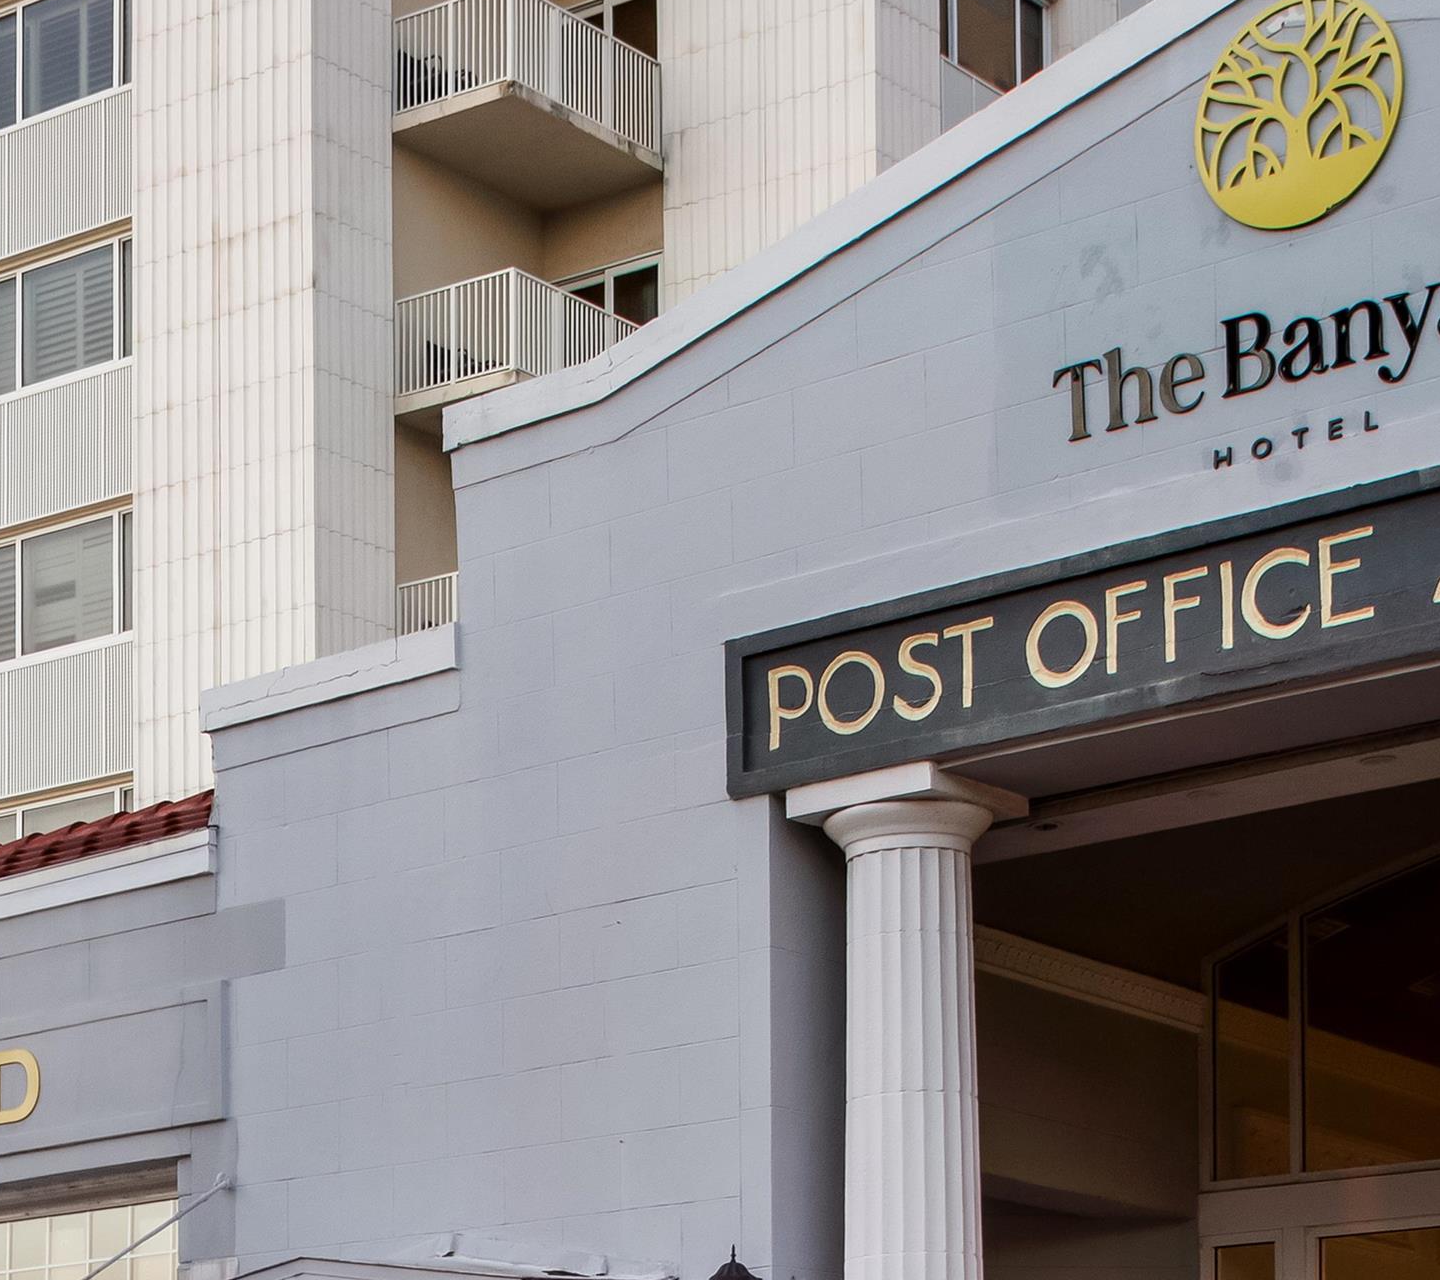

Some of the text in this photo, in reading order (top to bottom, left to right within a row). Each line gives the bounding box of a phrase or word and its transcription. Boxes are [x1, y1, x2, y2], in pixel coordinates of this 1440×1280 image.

[1052, 346, 1205, 442] The
[1213, 410, 1379, 470] HOTEL
[767, 616, 994, 752] POST
[1026, 525, 1375, 689] OFFICE
